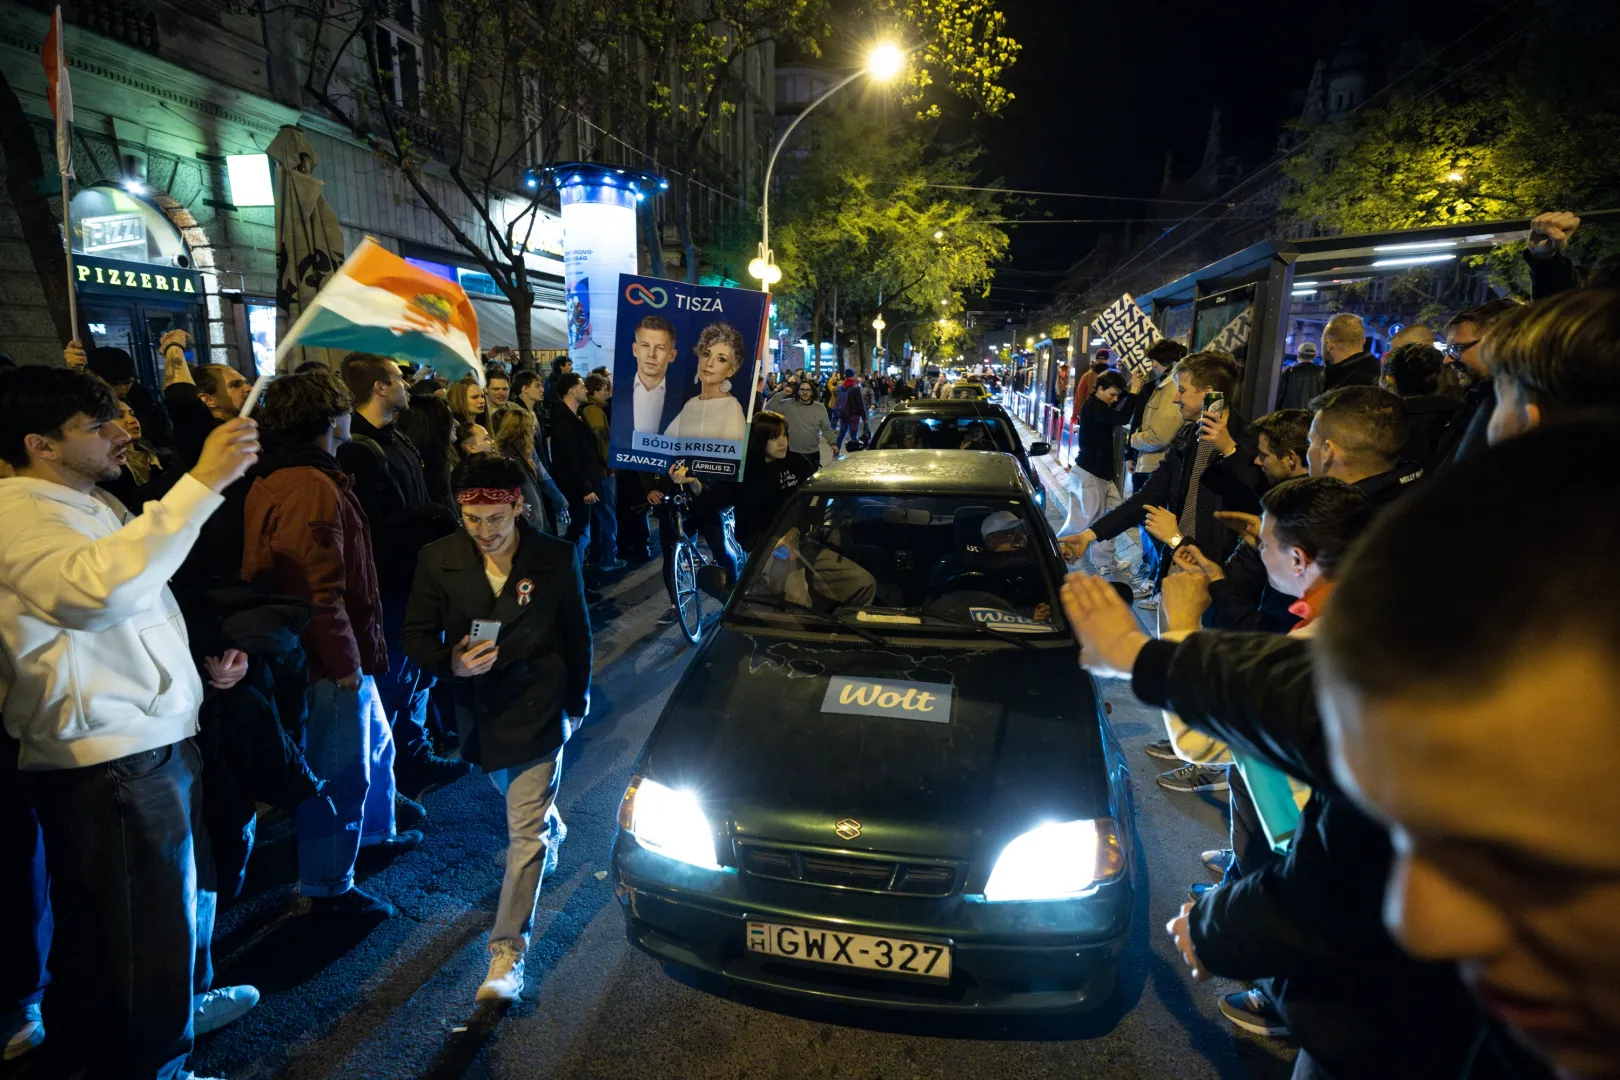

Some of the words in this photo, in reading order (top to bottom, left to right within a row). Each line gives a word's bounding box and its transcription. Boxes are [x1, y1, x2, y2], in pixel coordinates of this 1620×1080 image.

[76, 265, 196, 293] PIZZERIA
[675, 294, 723, 312] TISZA
[1091, 293, 1134, 333] TISZA
[1101, 306, 1144, 345] TISZA
[1111, 317, 1154, 357] TISZA
[642, 437, 681, 451] BÓDIS
[685, 442, 736, 454] KRISZTA
[616, 453, 667, 468] SZAVAZZ!
[695, 461, 722, 471] ÁPRILIS
[840, 684, 936, 712] Wolt
[751, 938, 764, 951] H
[777, 927, 943, 974] GWX-327
